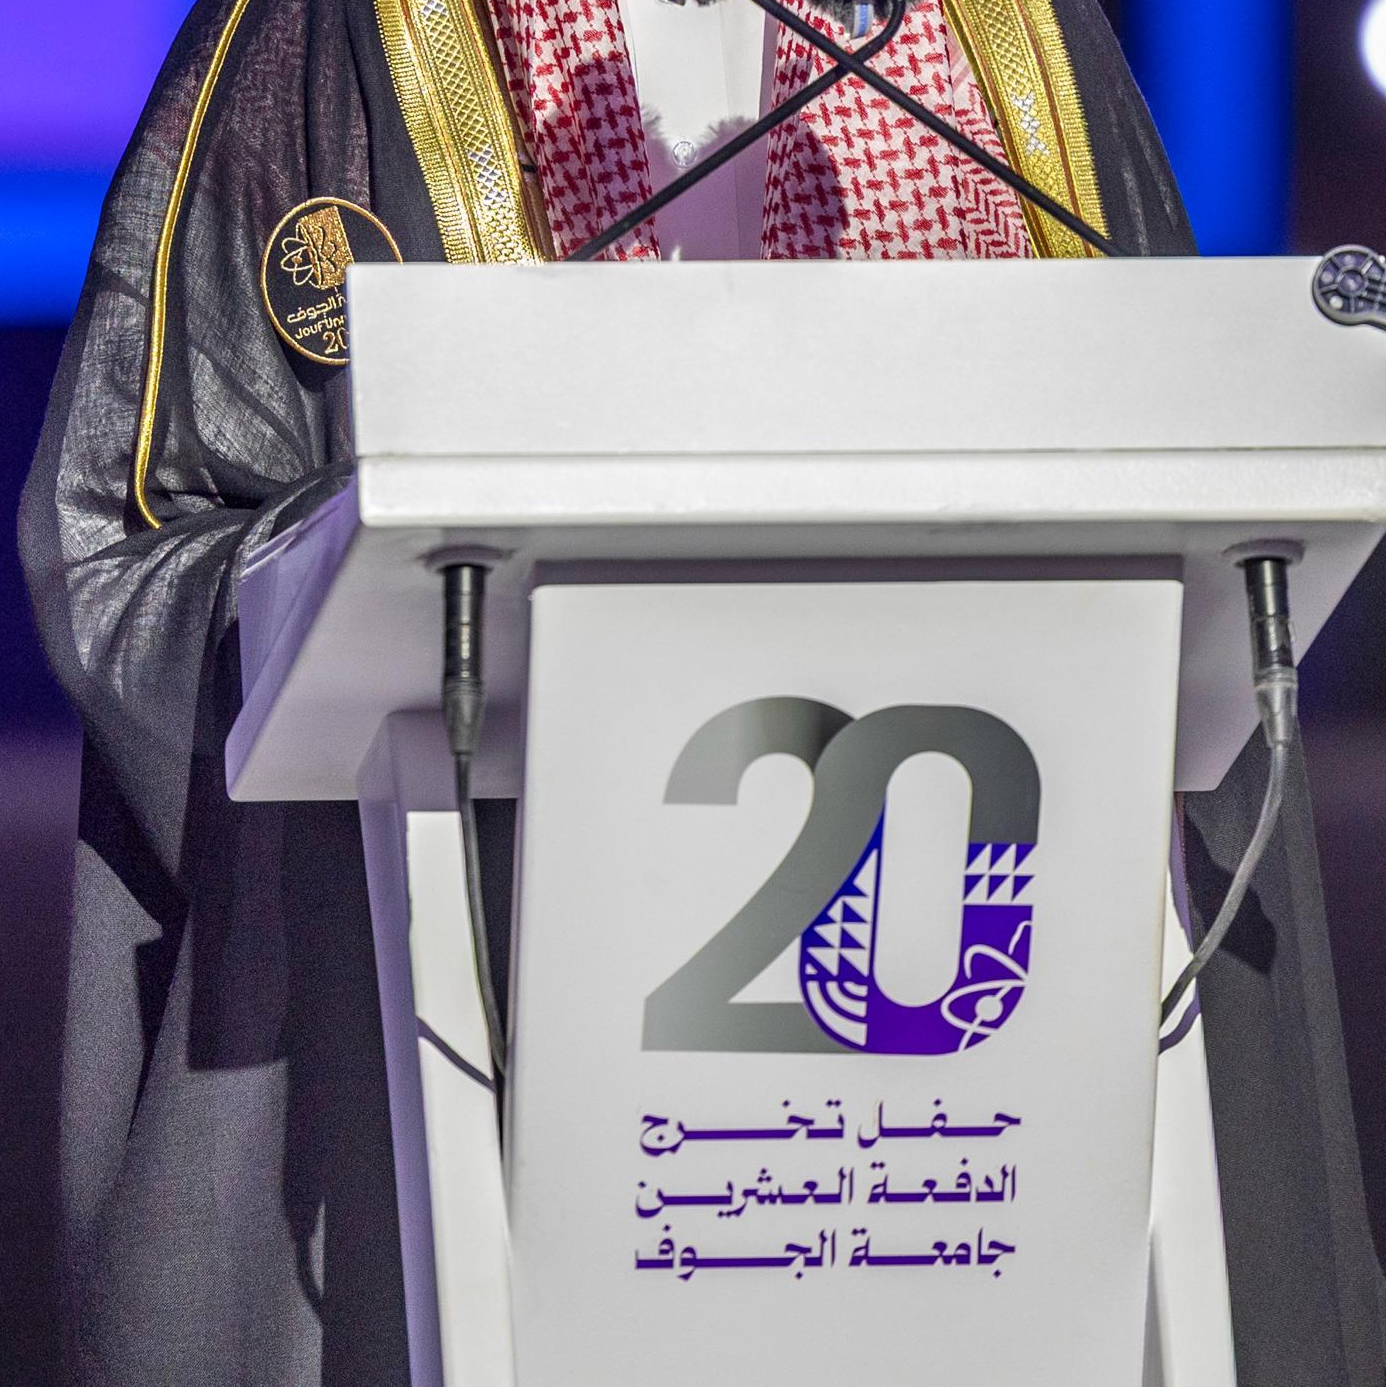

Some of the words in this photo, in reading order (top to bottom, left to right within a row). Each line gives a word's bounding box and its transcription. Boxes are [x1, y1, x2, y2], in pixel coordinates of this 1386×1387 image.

[287, 296, 337, 324] الجوف
[640, 694, 1041, 1056] 20
[639, 1099, 846, 1157] تخرج
[857, 1098, 1022, 1149] حفل
[635, 1168, 855, 1218] العشرين
[867, 1157, 1017, 1203] الدفعة
[635, 1224, 837, 1282] الجوف
[848, 1227, 1016, 1278] جامعة
